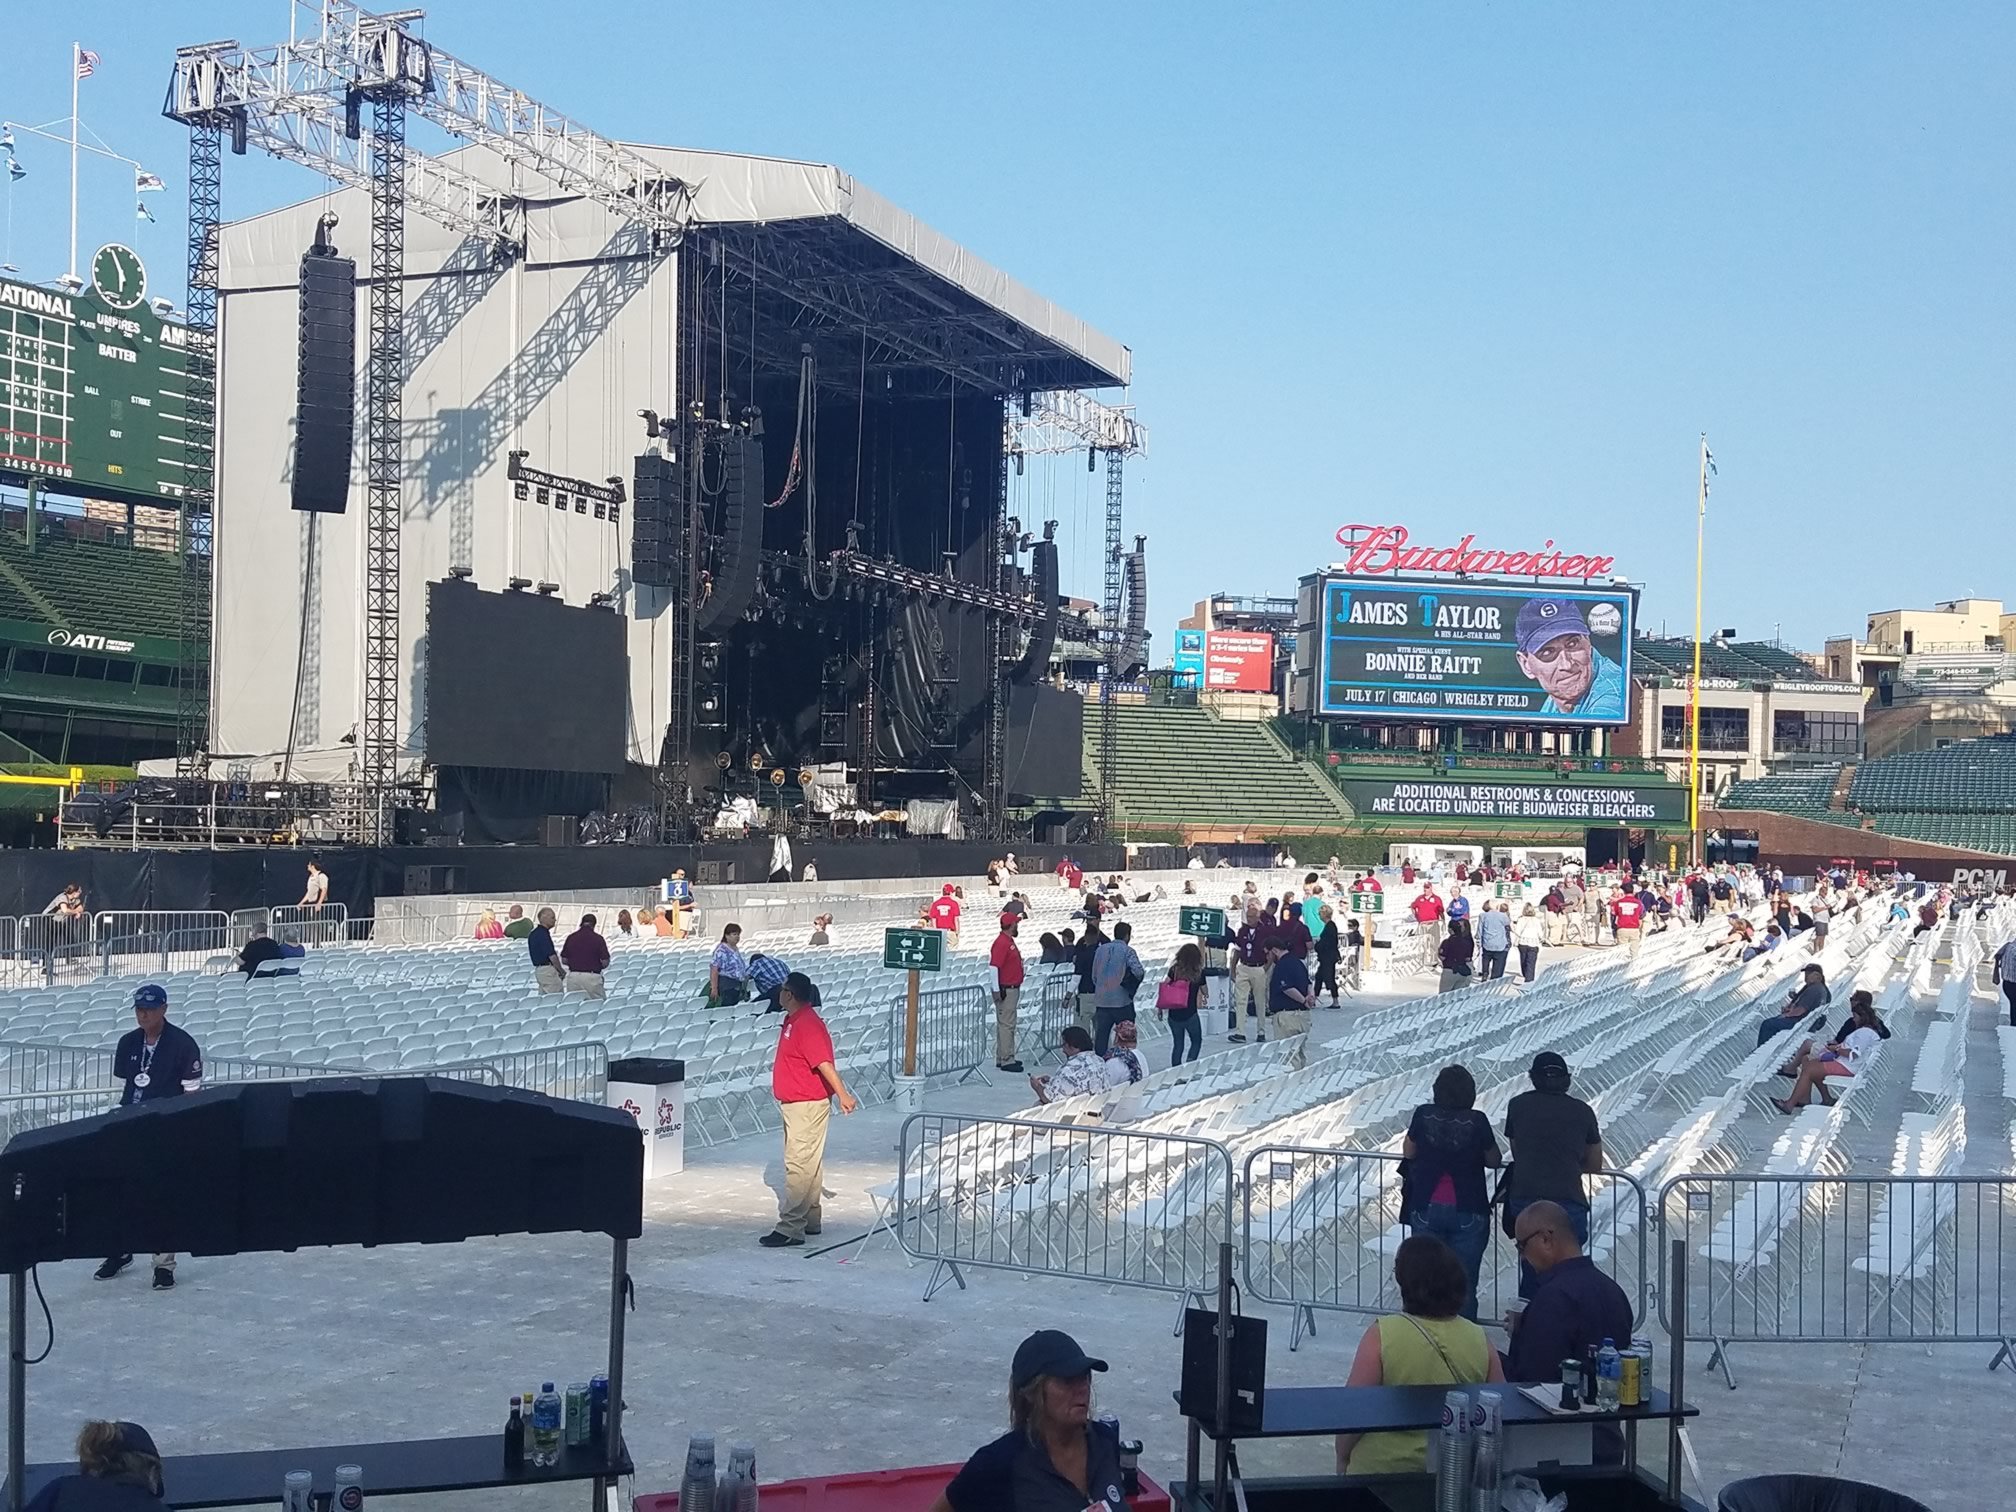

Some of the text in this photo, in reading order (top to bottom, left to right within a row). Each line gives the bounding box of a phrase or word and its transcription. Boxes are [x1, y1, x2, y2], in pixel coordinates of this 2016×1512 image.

[97, 313, 141, 334] UMPIRES
[7, 336, 47, 352] JAMES
[7, 348, 55, 365] TAYLOR
[99, 343, 137, 363] BATTER
[15, 374, 47, 387] WITH
[5, 384, 55, 401] BONNIE
[84, 385, 100, 396] BALL
[15, 398, 54, 412] RAITT
[131, 396, 151, 407] STRIKE
[4, 433, 27, 444] ULY
[110, 429, 122, 439] OUT
[4, 458, 72, 478] 3 4 5 6 7 8 9 10
[108, 465, 123, 475] HITS
[1336, 524, 1614, 578] Budweiser
[1336, 591, 1501, 630] JAMES TAYLOR
[69, 633, 105, 650] ATI
[1434, 630, 1439, 638] &
[1452, 631, 1483, 639] ALL-STAR
[1365, 652, 1482, 675] BONNIE RAITT
[1773, 682, 1861, 693] WRIGLEYROOFTOPS.COM
[1344, 688, 1529, 707] JULY 17 CHICAGO WRIGLEY FIELD
[1393, 784, 1635, 803] ADDITIONAL RESTROOMS & CONCESSIONS
[1372, 798, 1655, 817] ARE LOCATED UNDER THE BUDWEISER BLEACHERS
[1952, 868, 2007, 890] PCM
[1190, 921, 1198, 931] S
[1202, 913, 1210, 923] H
[917, 937, 925, 949] J
[900, 949, 908, 961] T
